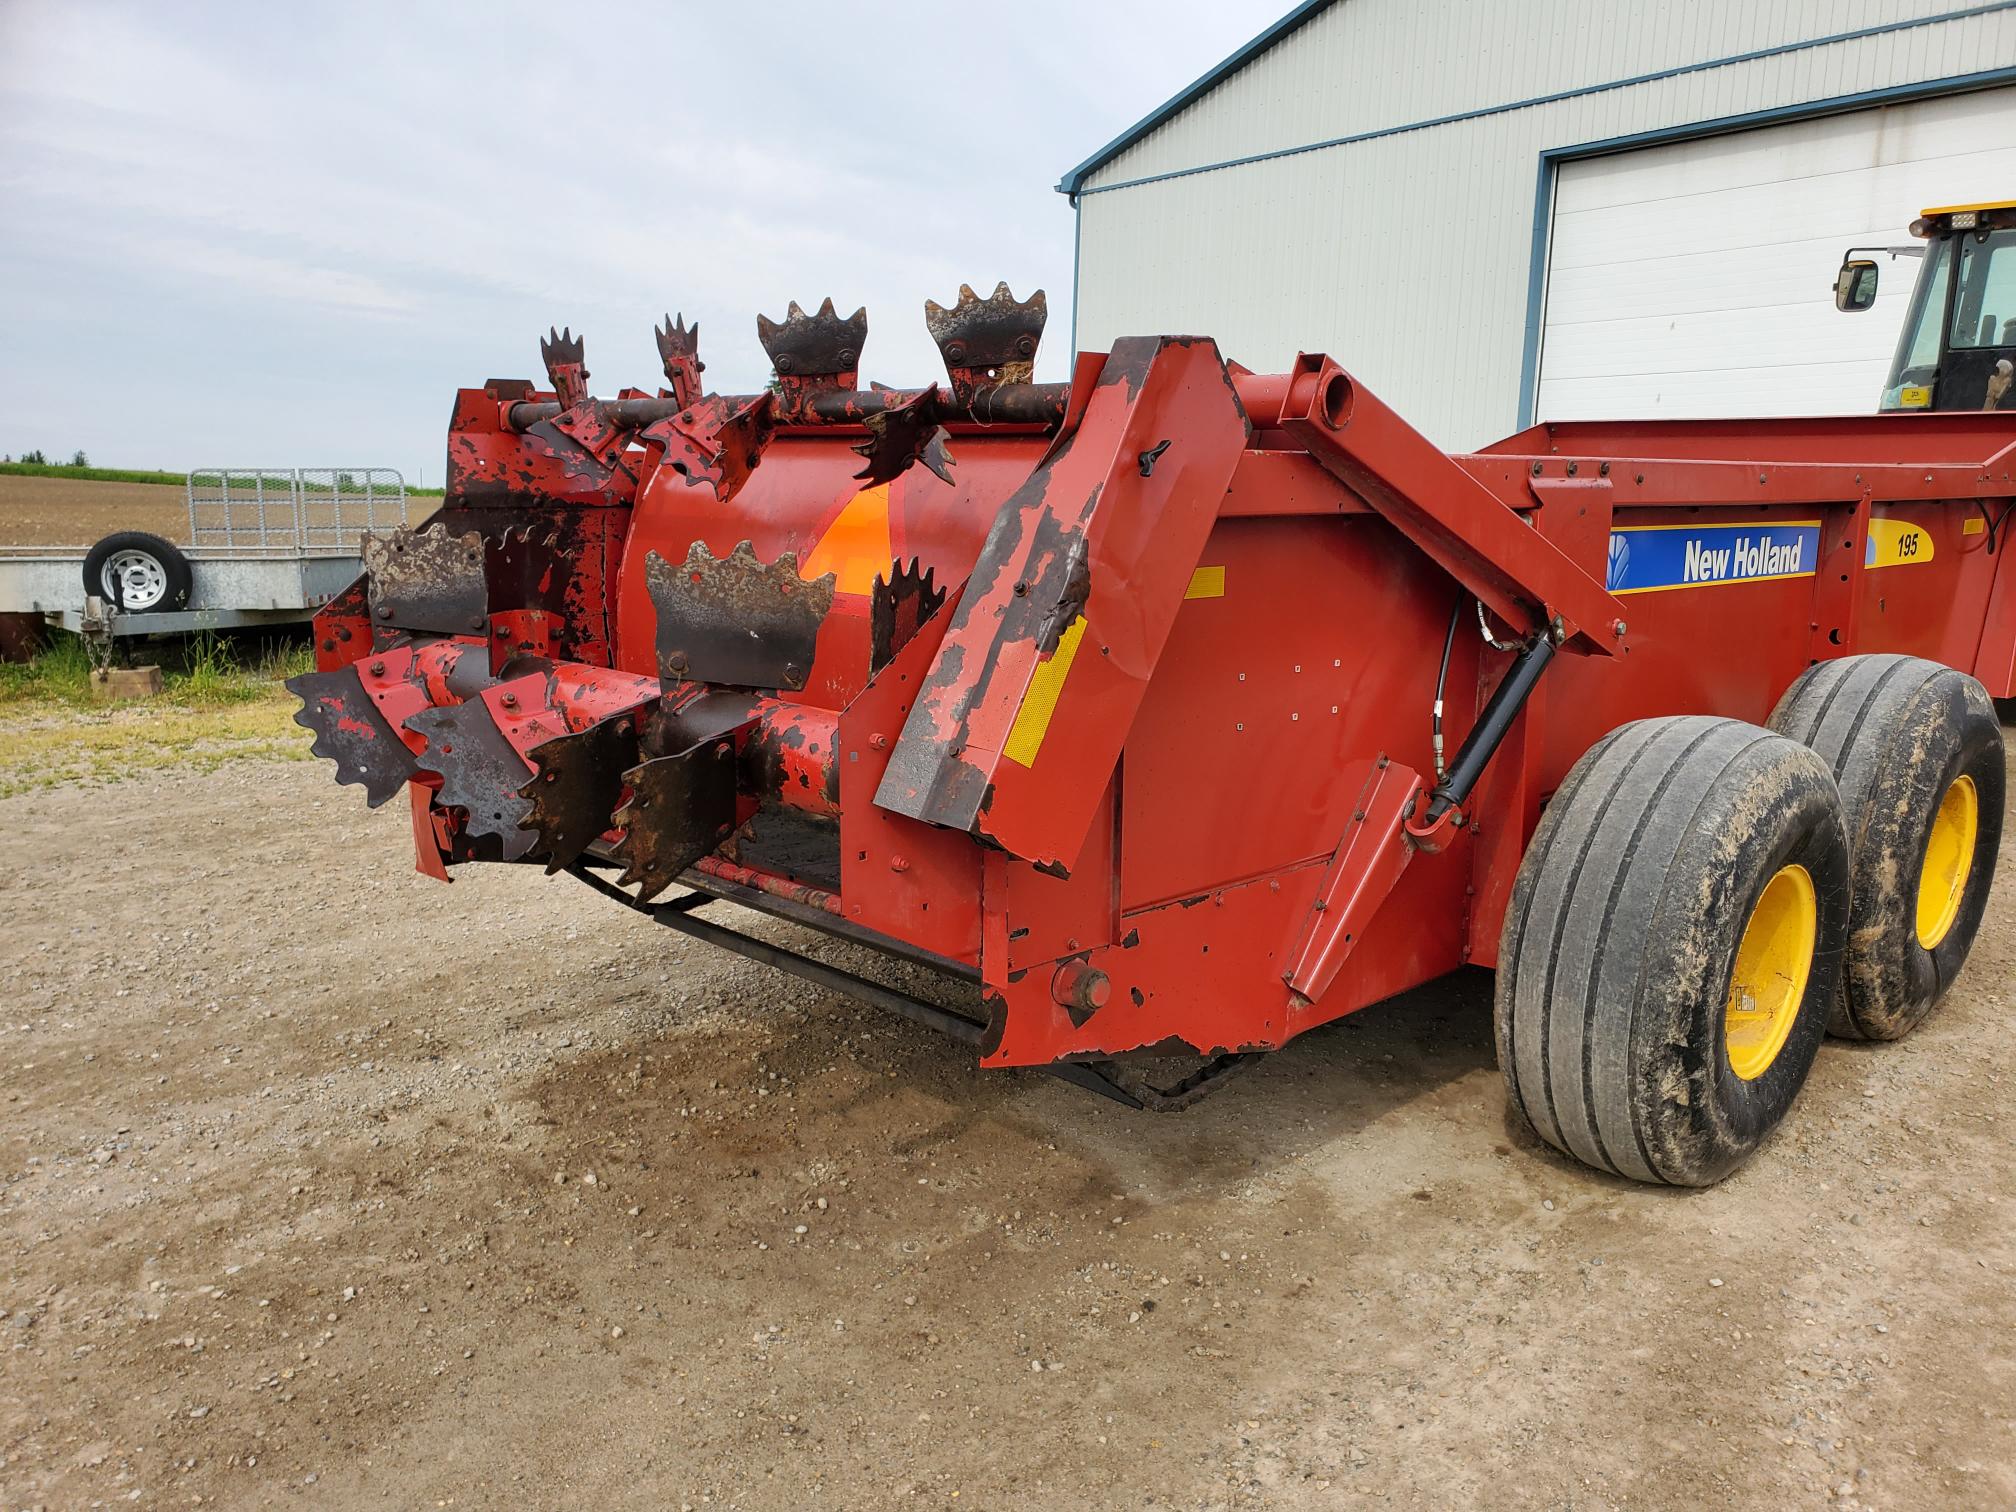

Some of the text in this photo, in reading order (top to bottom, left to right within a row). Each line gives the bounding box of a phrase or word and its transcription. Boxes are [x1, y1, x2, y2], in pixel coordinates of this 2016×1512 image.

[1683, 535, 1803, 581] New Holland
[1898, 533, 1918, 557] 195
